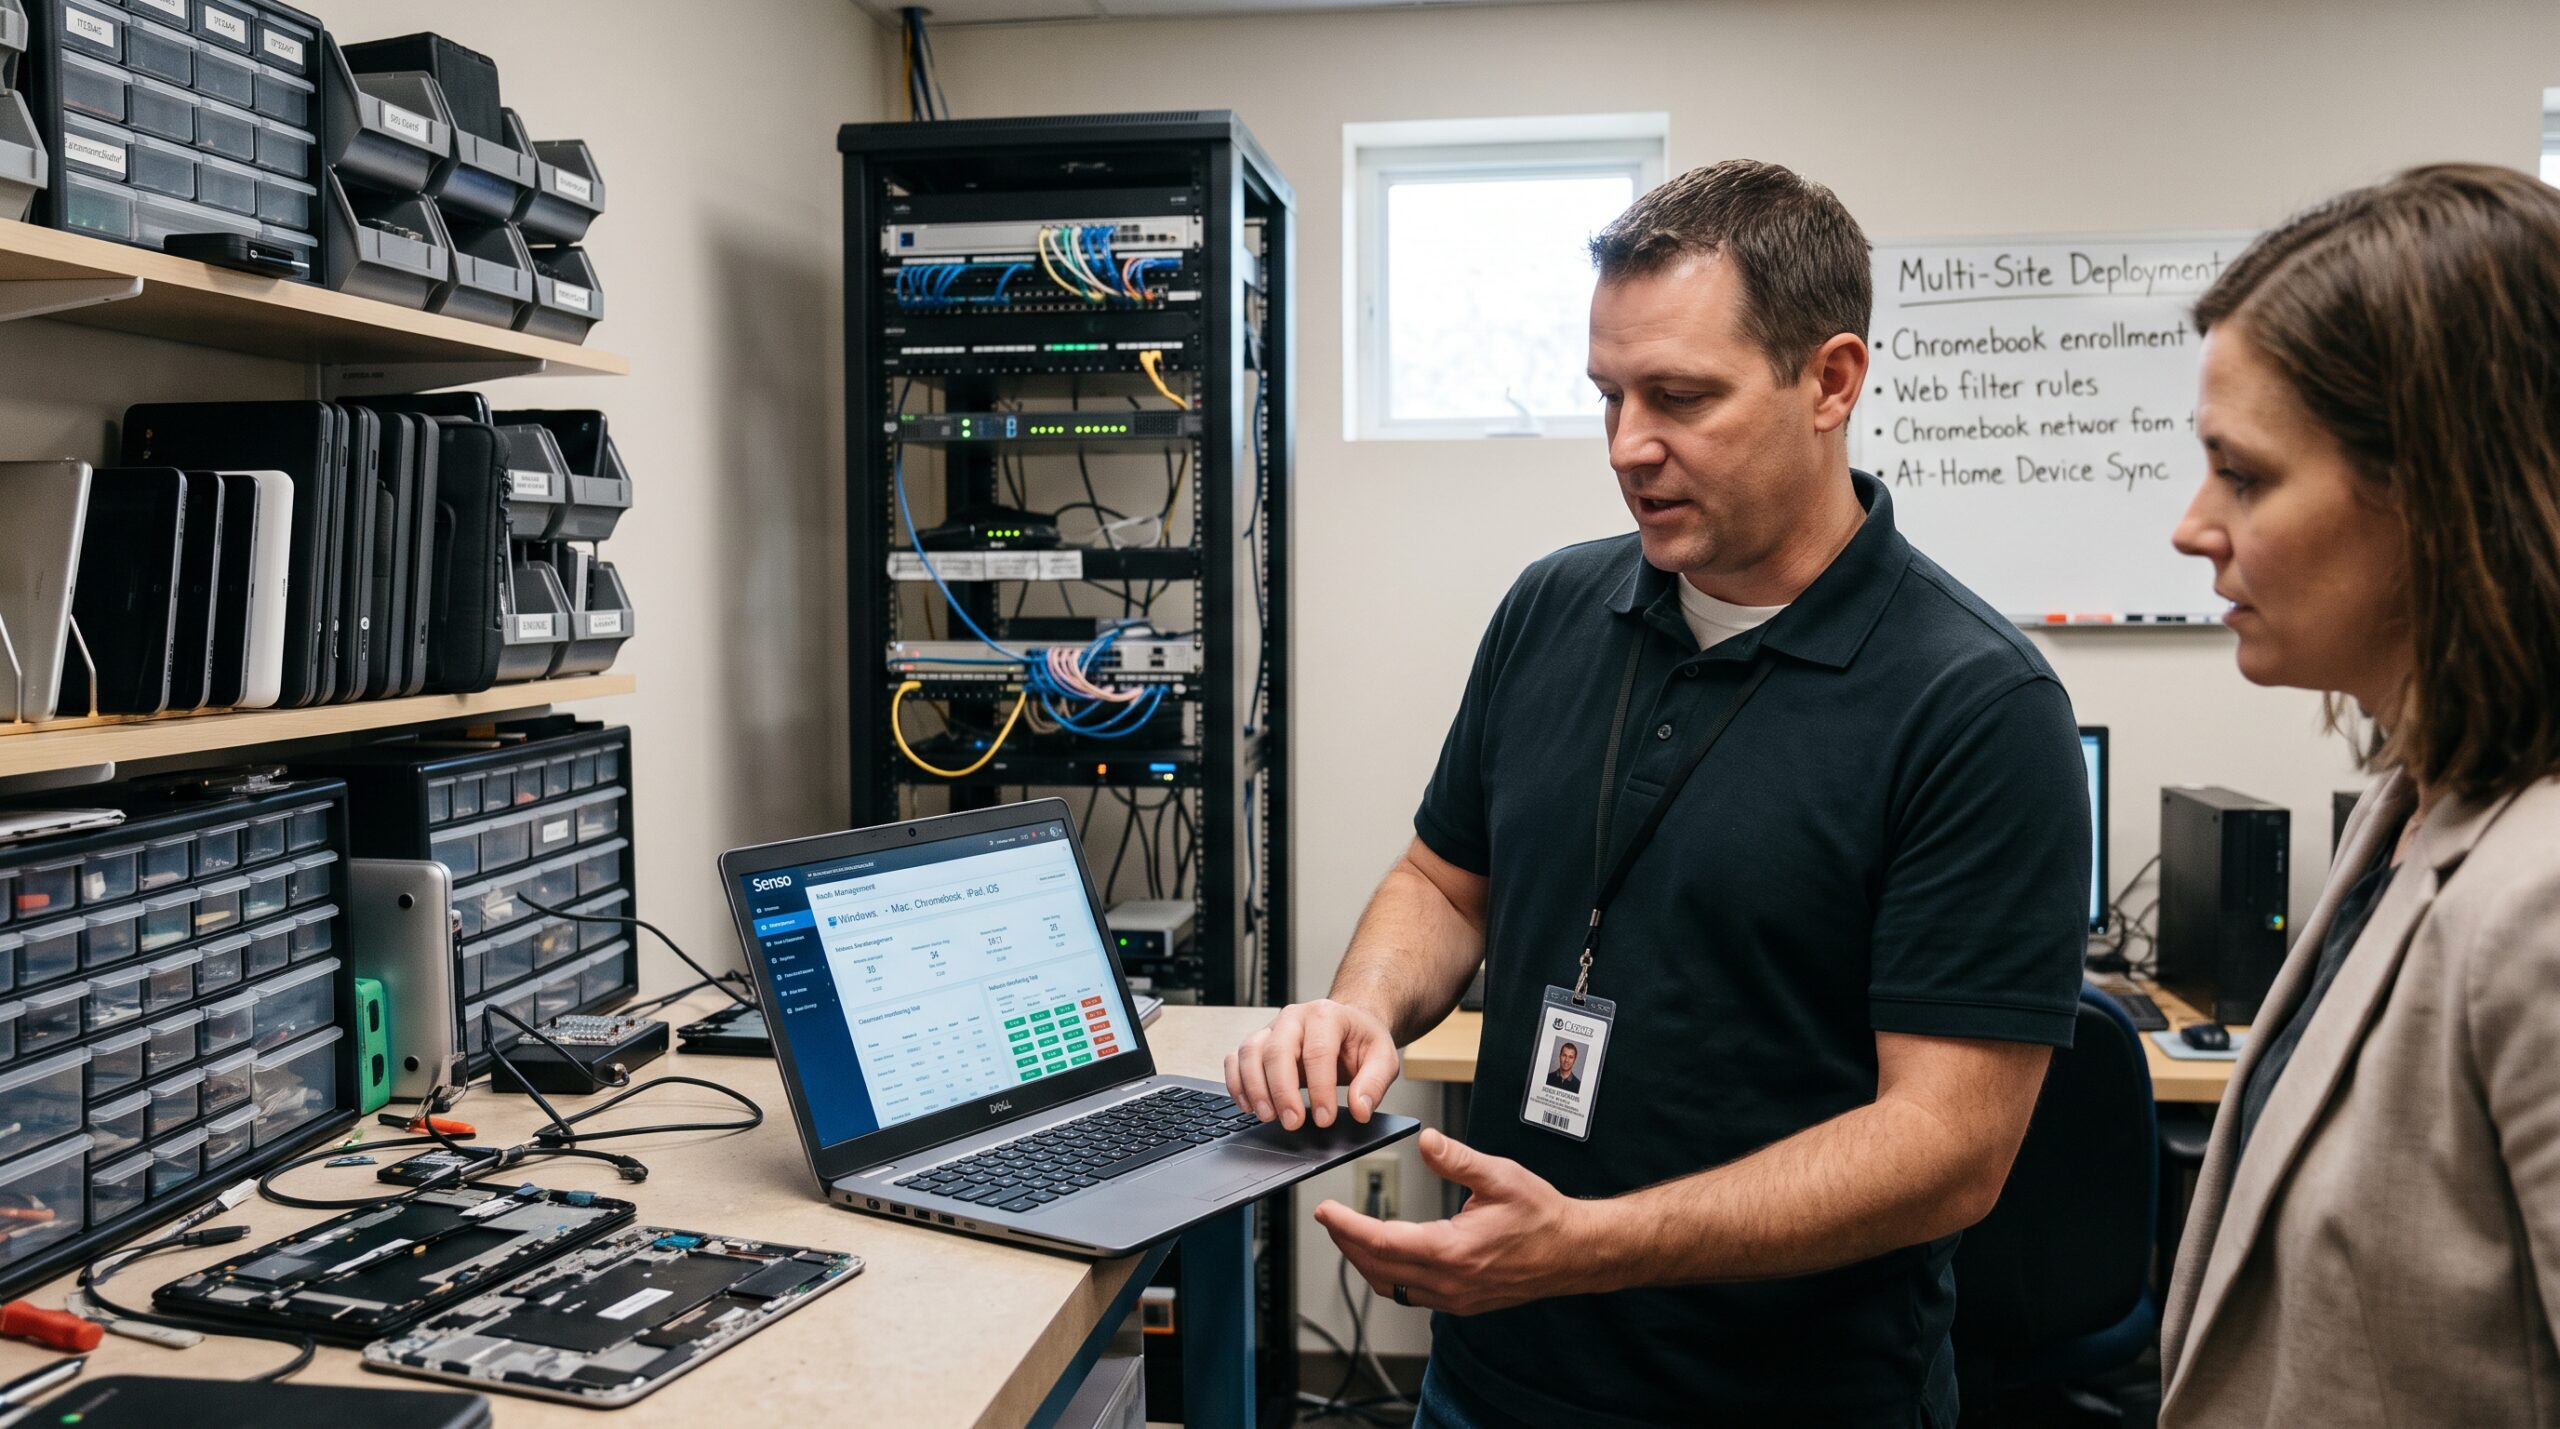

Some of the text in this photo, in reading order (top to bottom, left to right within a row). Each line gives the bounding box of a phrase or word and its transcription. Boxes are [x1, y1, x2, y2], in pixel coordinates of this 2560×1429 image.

[1898, 251, 2226, 296] Multi-Site Deployment
[1892, 321, 2187, 361] Chromebook enrollment
[1893, 369, 2099, 403] Web filter rules
[1893, 414, 2030, 444] Chromebook
[2040, 412, 2119, 437] networ
[2130, 405, 2175, 433] fom
[1896, 452, 2170, 493] At-Home Device Sync
[752, 875, 792, 892] Senso
[834, 883, 876, 899] Management
